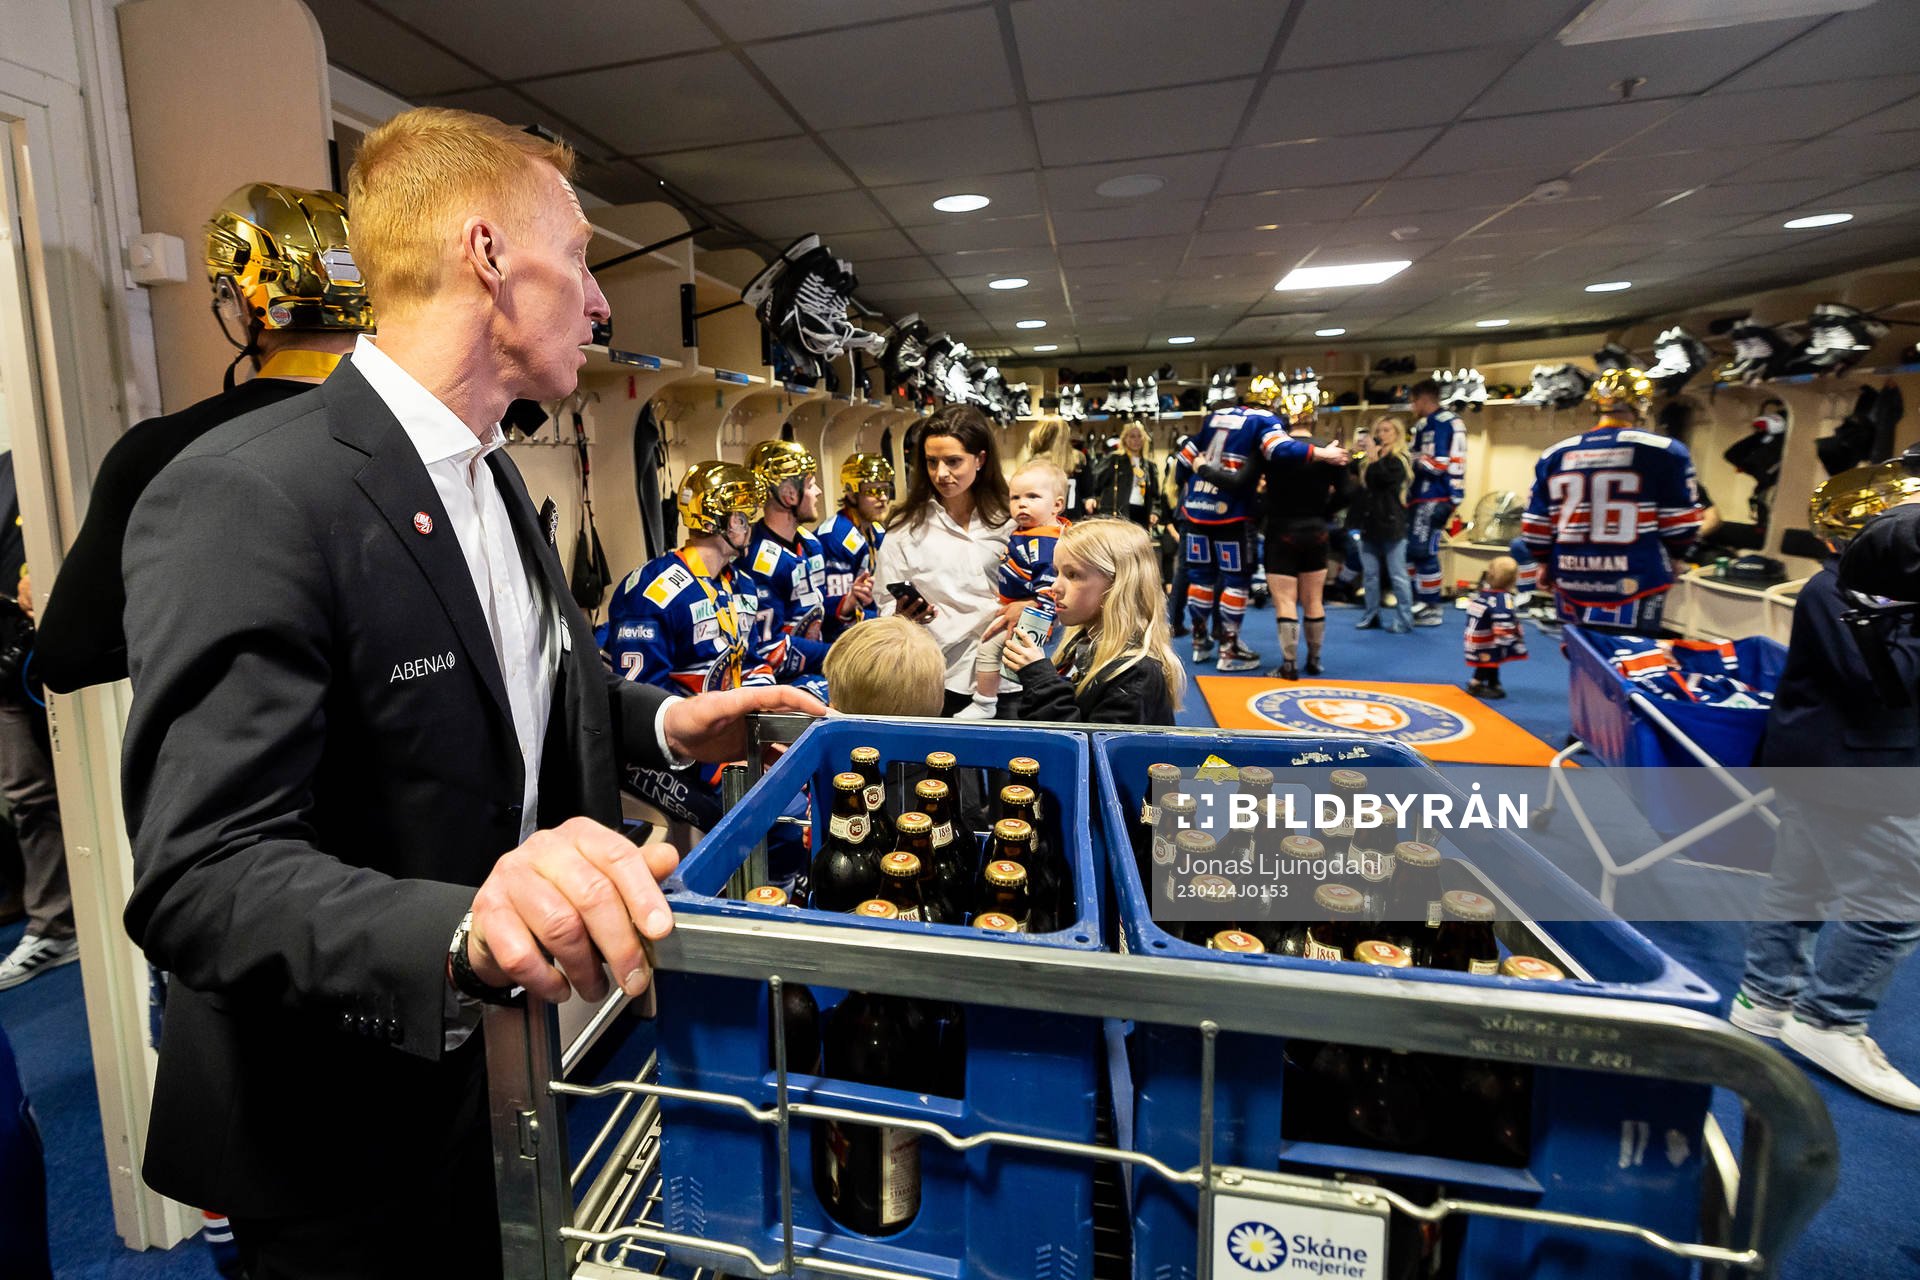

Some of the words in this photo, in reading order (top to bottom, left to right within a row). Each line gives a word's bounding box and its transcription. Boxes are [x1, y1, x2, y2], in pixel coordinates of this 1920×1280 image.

[1549, 470, 1640, 544] 26
[390, 654, 447, 683] ABENA
[620, 651, 645, 681] 2
[1292, 1234, 1368, 1264] Skåne
[1291, 1257, 1367, 1279] mejerier
